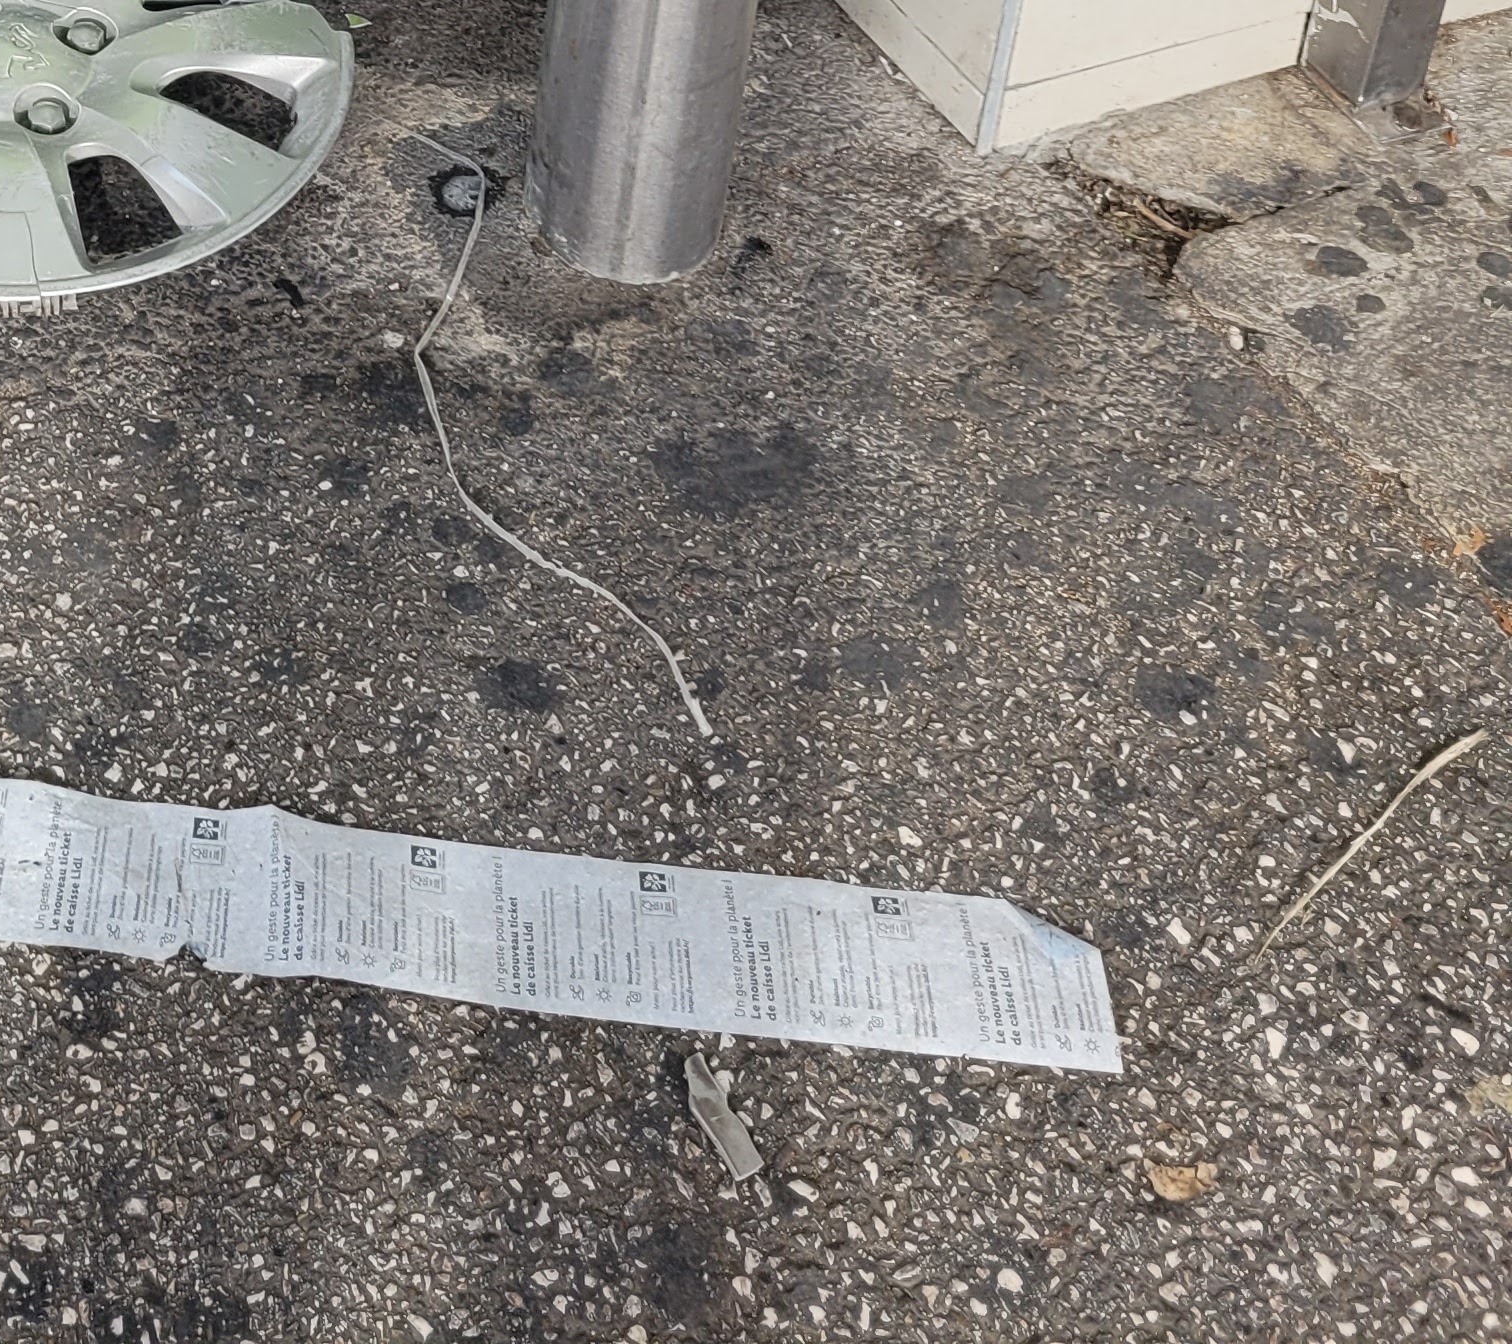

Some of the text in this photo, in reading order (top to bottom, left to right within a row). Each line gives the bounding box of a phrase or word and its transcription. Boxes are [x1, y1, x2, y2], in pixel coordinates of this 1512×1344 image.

[46, 842, 57, 852] la
[44, 853, 55, 881] pour
[49, 830, 72, 931] Le nouveau ticket
[271, 867, 279, 878] la
[40, 883, 51, 911] geste
[64, 858, 83, 934] de caisse Lidl
[270, 881, 280, 908] pour
[279, 855, 292, 962] Le nouveau ticket
[35, 915, 47, 931] Un
[294, 881, 305, 961] de caisse Lidl
[493, 905, 504, 914] la
[268, 911, 279, 942] geste
[496, 916, 506, 943] pour
[727, 926, 738, 935] la
[264, 946, 276, 962] Un
[497, 945, 508, 975] geste
[508, 897, 521, 996] Le nouveau ticket
[523, 922, 537, 997] de caisse Lidl
[731, 937, 744, 964] pour
[966, 950, 977, 959] la
[734, 966, 748, 997] geste
[742, 917, 762, 1020] Le nouveau ticket
[759, 941, 777, 1022] de caisse Lidl
[970, 962, 985, 989] pour
[496, 978, 507, 993] Un
[981, 942, 1006, 1044] Le nouveau ticket
[734, 1000, 746, 1017] Un
[975, 991, 990, 1023] geste
[999, 967, 1022, 1046] de caisse Lidl
[979, 1026, 991, 1042] Un
